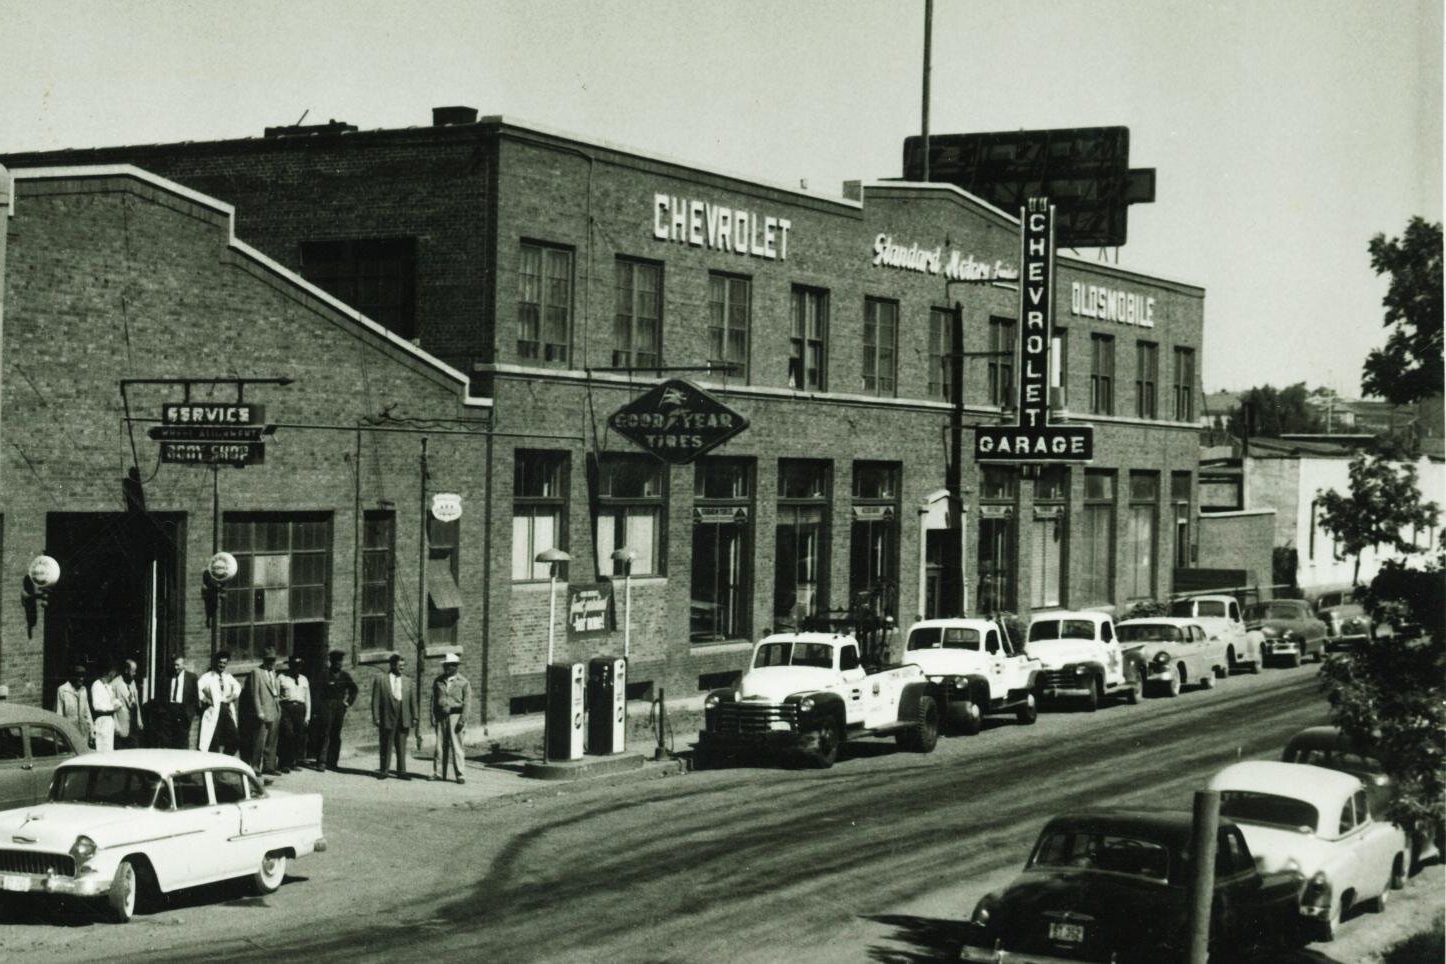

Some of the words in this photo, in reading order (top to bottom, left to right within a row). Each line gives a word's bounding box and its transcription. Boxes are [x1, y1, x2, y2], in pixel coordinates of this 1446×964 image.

[654, 193, 792, 260] CHEVROLET
[1071, 282, 1155, 327] OLDSMOBILE
[1025, 213, 1047, 427] CHEVROLET
[167, 407, 250, 422] SERVICE
[646, 434, 703, 448] TIRES
[979, 436, 1085, 454] GARAGE
[210, 444, 250, 461] SHOP
